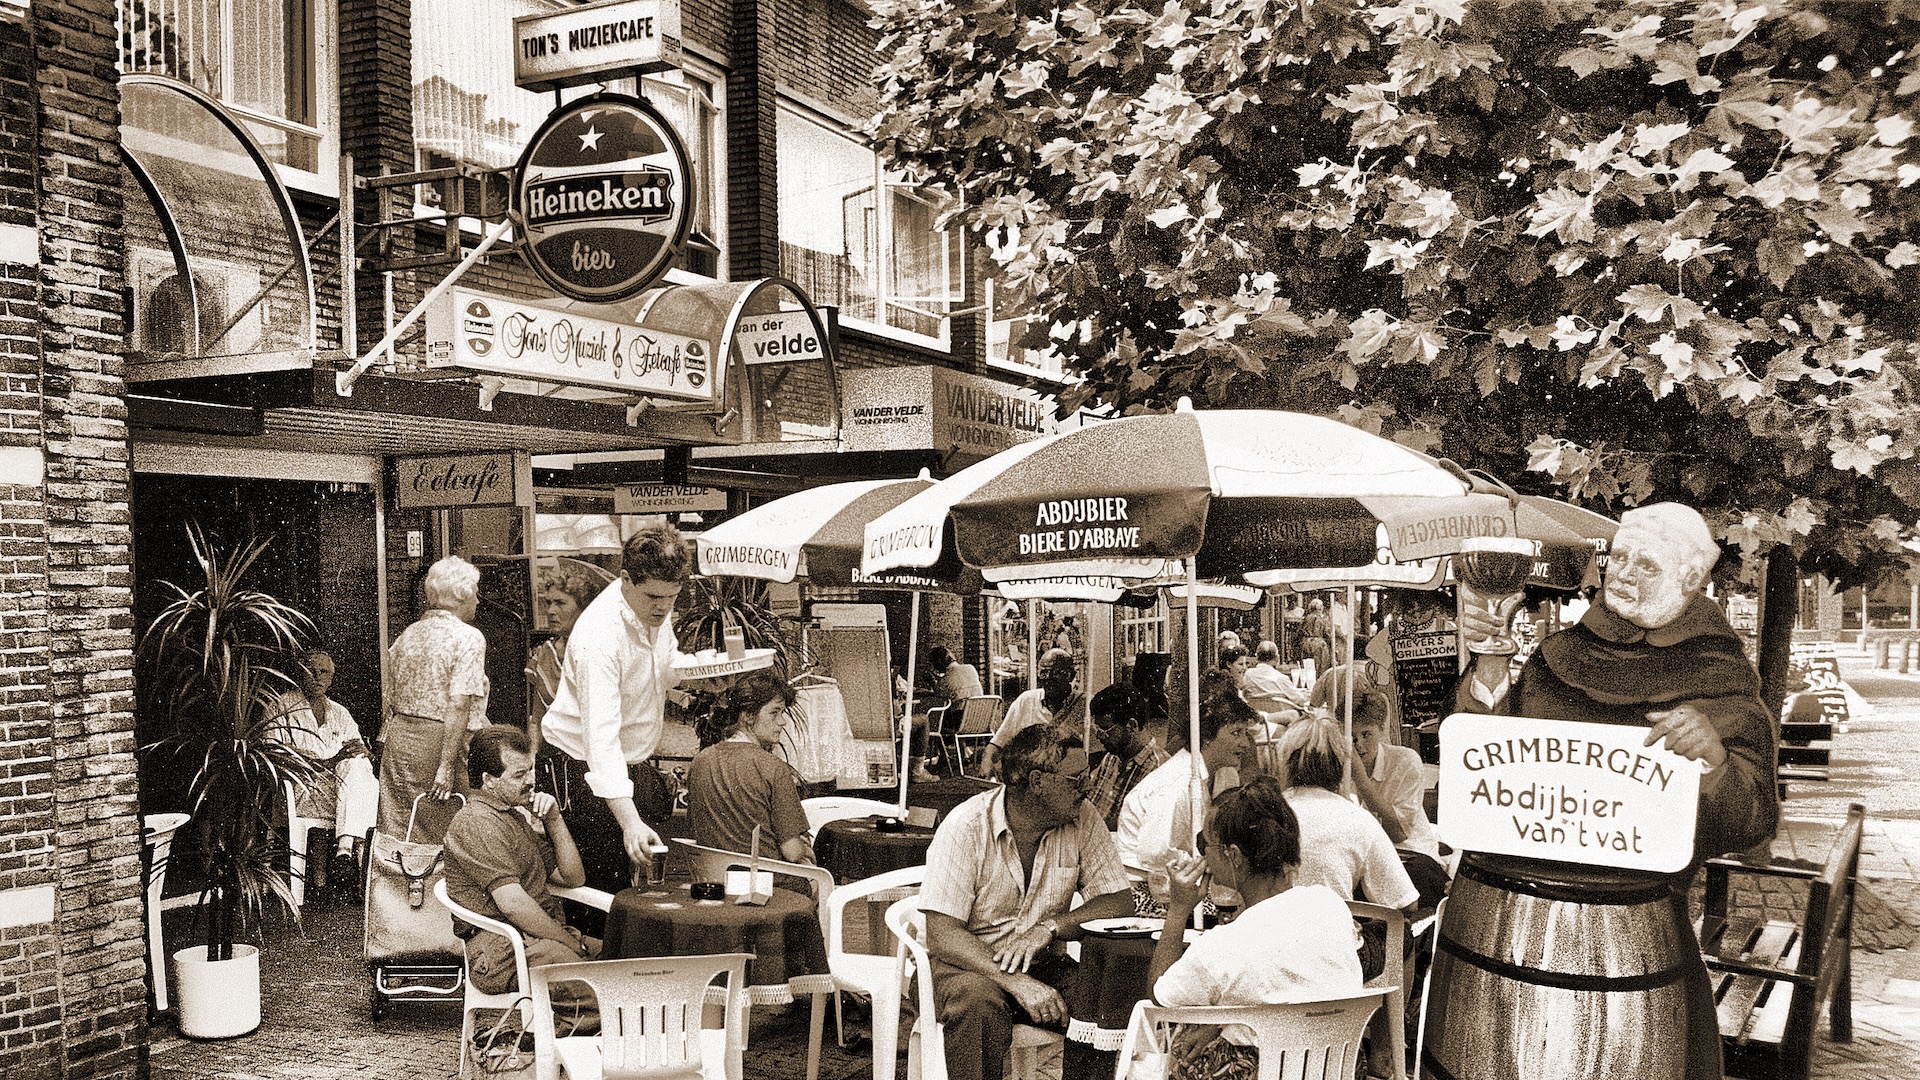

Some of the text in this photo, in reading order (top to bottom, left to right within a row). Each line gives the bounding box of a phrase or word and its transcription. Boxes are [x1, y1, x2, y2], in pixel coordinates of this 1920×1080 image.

[523, 33, 559, 59] TON'S
[568, 16, 654, 52] MUZIEKCAFE
[529, 180, 665, 219] Heineken
[571, 240, 616, 272] bier
[762, 319, 784, 332] der
[502, 312, 548, 359] Ton's
[550, 318, 608, 368] Muziek
[753, 333, 818, 358] velde
[894, 405, 924, 416] VELDE
[1006, 396, 1045, 434] VELDE
[676, 485, 709, 496] VELDE
[1035, 497, 1128, 526] ABDIJBIER
[1019, 527, 1141, 555] BIERE D'ABBAYE
[706, 546, 790, 570] GRIMBERGEN
[1397, 645, 1456, 659] GRILLROOM
[685, 661, 744, 678] GRIMBERGEN
[1463, 737, 1674, 792] GRIMBERGEN
[1470, 778, 1623, 820] Abdijbier
[1596, 826, 1643, 854] vat
